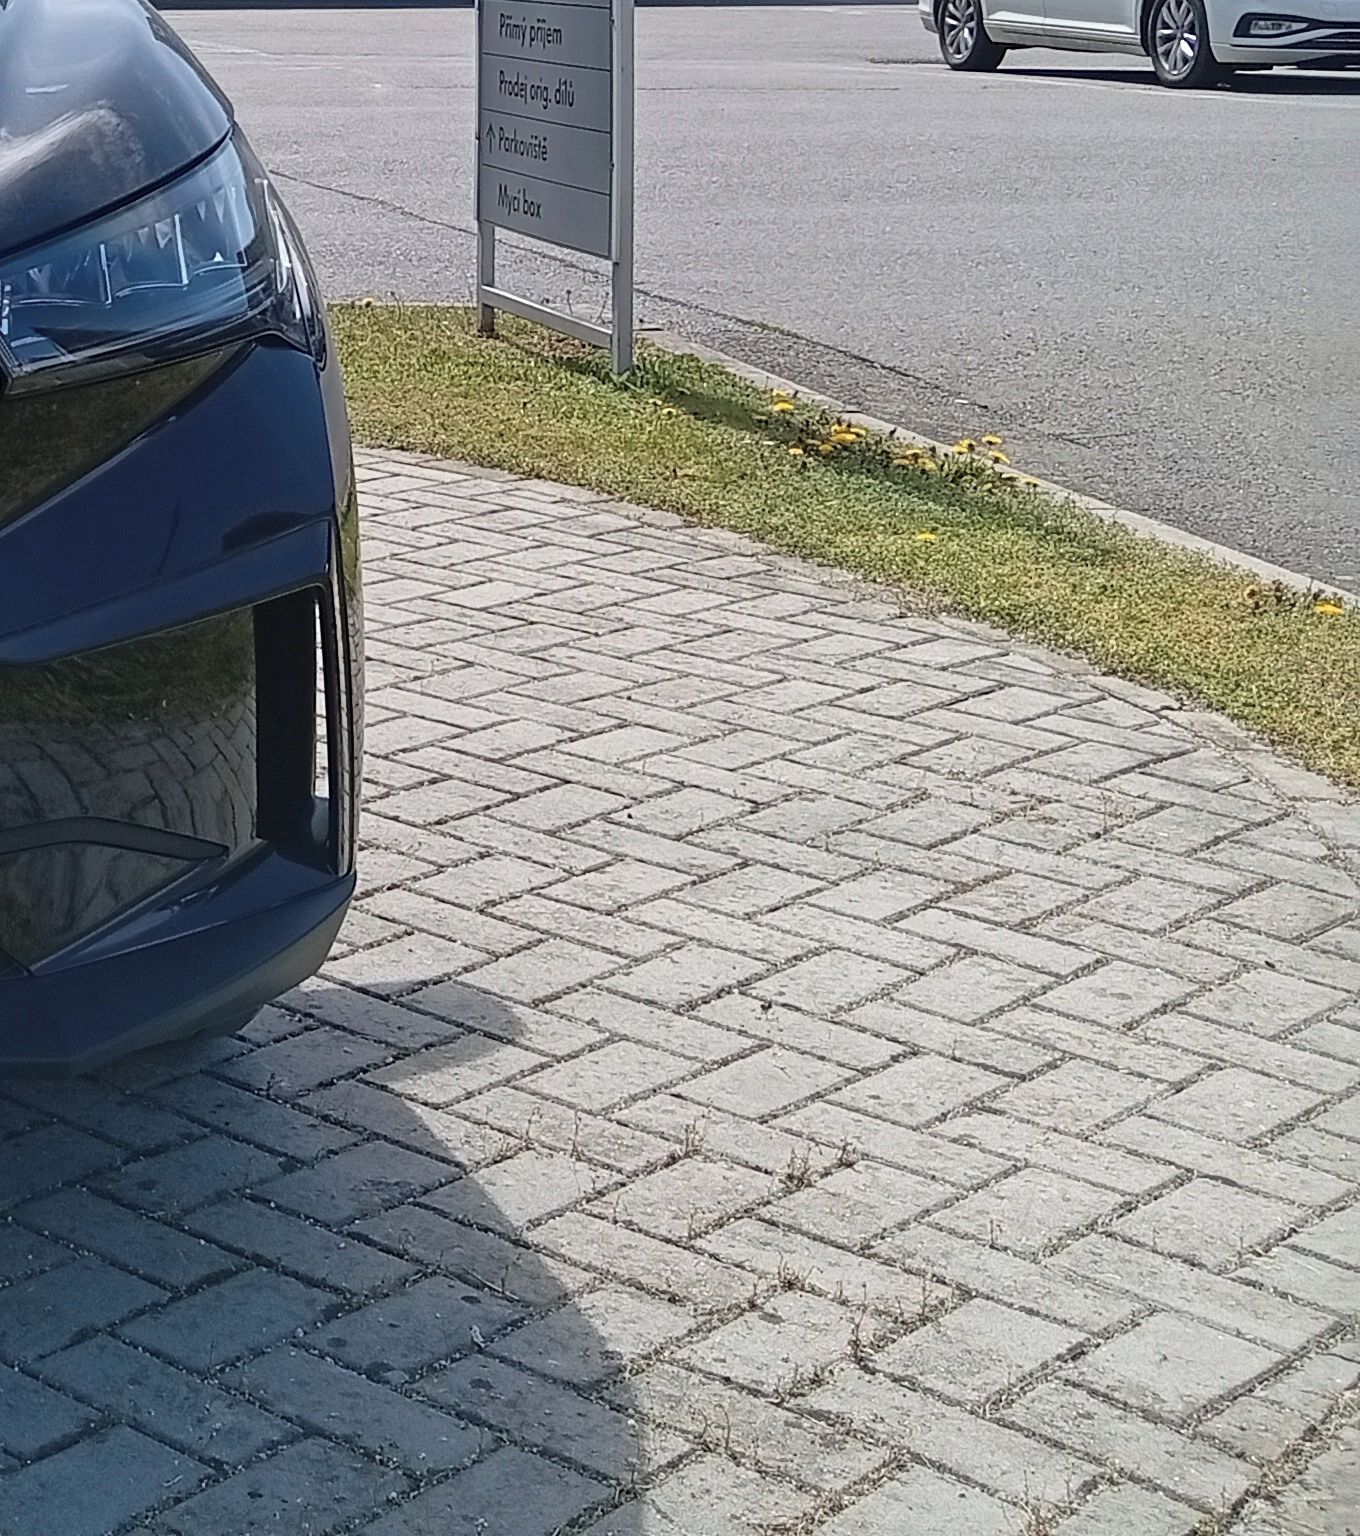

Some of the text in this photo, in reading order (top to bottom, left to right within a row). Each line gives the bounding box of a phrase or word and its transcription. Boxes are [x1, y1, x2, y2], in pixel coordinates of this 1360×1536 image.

[499, 70, 528, 104] Prodej
[529, 77, 552, 110] orig.
[498, 126, 548, 161] Parkoviště
[497, 183, 542, 219] Mycí box
